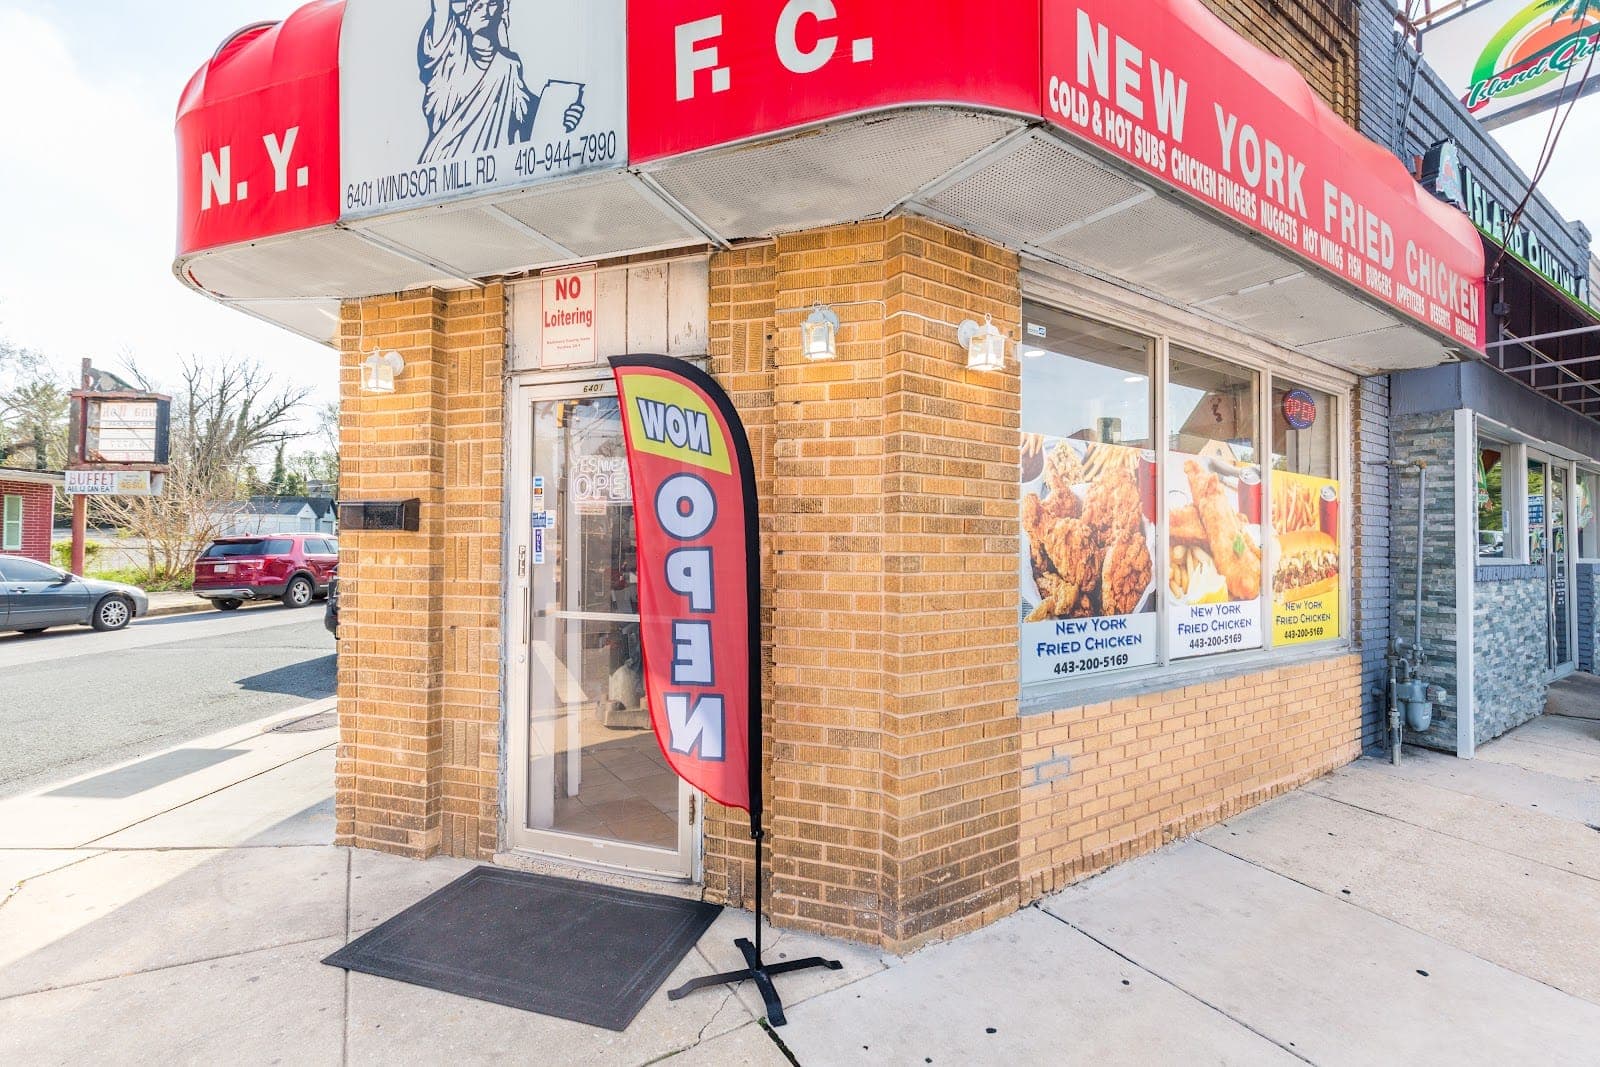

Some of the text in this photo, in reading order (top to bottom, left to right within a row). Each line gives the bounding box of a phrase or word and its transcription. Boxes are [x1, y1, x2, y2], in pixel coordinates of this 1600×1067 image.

[675, 0, 873, 101] F. C.
[1467, 58, 1547, 107] Island
[201, 126, 308, 210] N. Y.
[347, 130, 616, 209] 6401 WINDSOR MILL RD. 410-944-7990
[1077, 8, 1478, 325] NEW YORK FRIED CHICKEN
[1049, 76, 1089, 128] COLD
[1092, 100, 1103, 137] &
[1105, 107, 1133, 152] HOT
[1135, 125, 1166, 172] SUBS
[1171, 148, 1217, 200] CHICKEN
[1218, 174, 1256, 221] FINGERS
[1261, 200, 1298, 245] NUGGETS
[1303, 224, 1319, 256] HOT
[1320, 234, 1343, 271] WINGS
[1348, 252, 1362, 281] FISH
[1366, 263, 1392, 299] BURGERS
[555, 276, 581, 301] NO
[544, 308, 592, 328] Loitering
[583, 384, 604, 393] 6401
[69, 472, 115, 486] BUFFET
[1190, 604, 1241, 618] NEW YORK
[1285, 600, 1323, 611] NEW YORK
[1056, 618, 1127, 636] NEW YORK
[1178, 618, 1252, 635] FRIED CHICKEN
[1276, 613, 1331, 626] FRIED CHICKEN
[1189, 633, 1242, 649] 443-200-5169
[1284, 627, 1324, 639] 443-200-5169
[1036, 634, 1142, 657] FRIED CHICKEN
[1054, 653, 1129, 674] 443-200-5169
